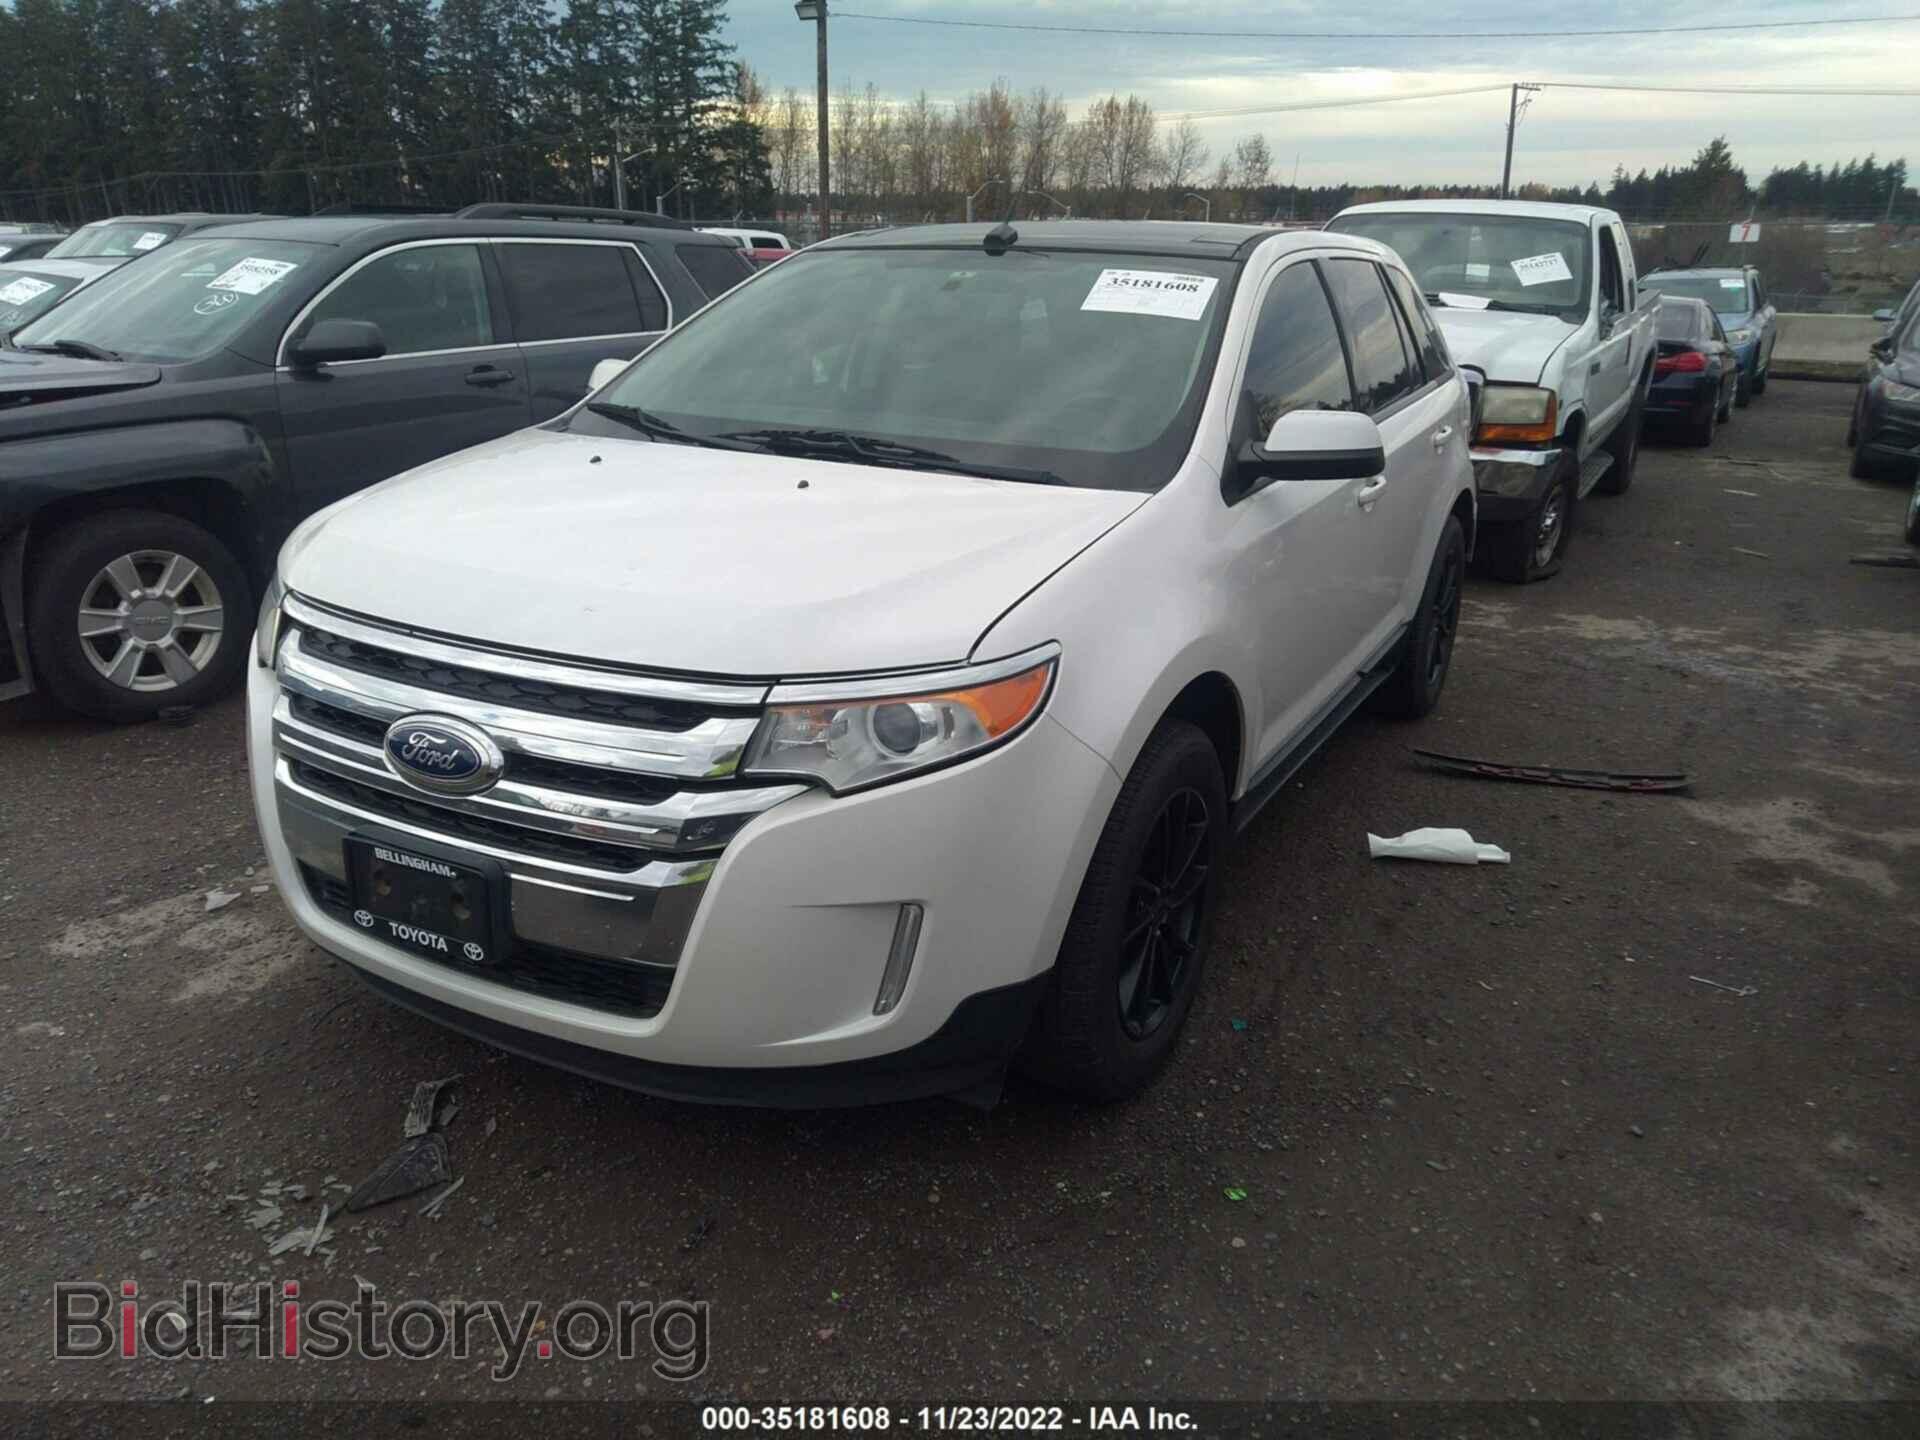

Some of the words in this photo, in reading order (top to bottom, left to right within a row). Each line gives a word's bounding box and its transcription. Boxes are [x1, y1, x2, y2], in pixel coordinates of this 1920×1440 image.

[1741, 223, 1751, 241] 7
[1106, 277, 1199, 292] 35181608
[401, 731, 459, 770] Ford
[374, 847, 452, 878] BELLINGHAM
[388, 922, 449, 953] TOYOTA
